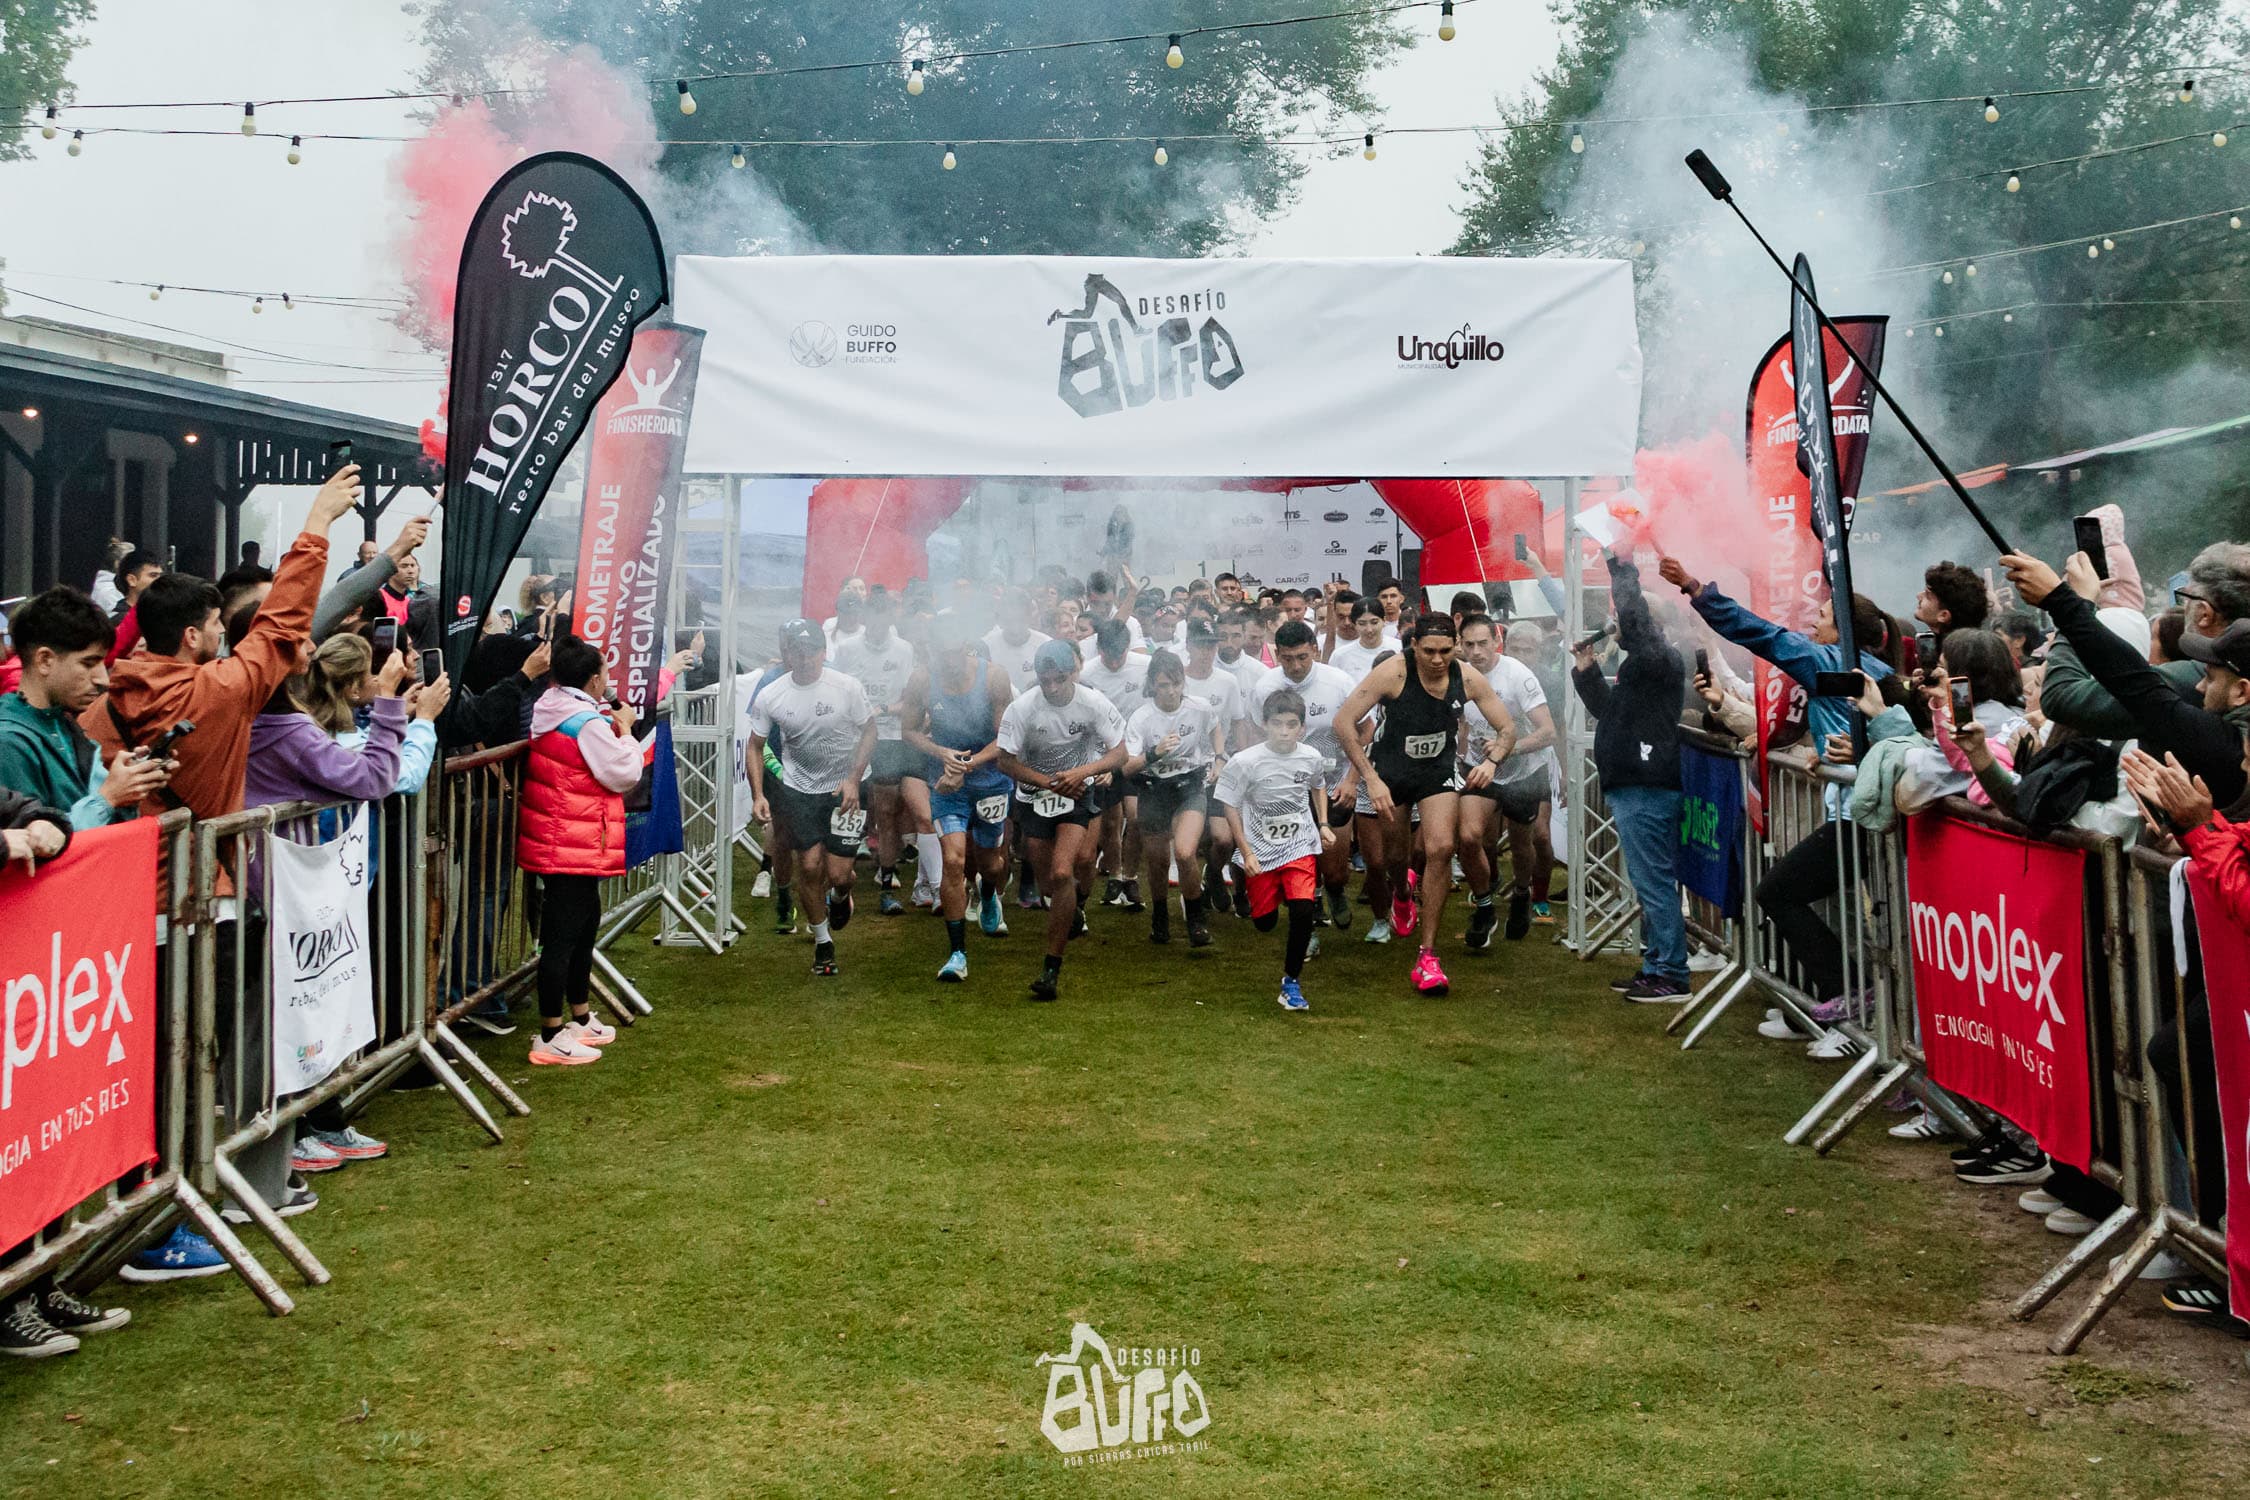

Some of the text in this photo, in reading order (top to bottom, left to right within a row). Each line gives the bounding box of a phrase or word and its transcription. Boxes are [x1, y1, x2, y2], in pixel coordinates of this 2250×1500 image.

[1139, 288, 1226, 316] DESAFÍO
[847, 324, 897, 337] GUIDO
[846, 341, 897, 353] BUFFO
[1398, 322, 1505, 370] Unquillo
[486, 348, 514, 391] 1317
[1058, 316, 1245, 419] BUFFO
[464, 286, 591, 497] HORCO
[509, 288, 640, 514] resto bar del museo
[1413, 741, 1439, 755] 197
[983, 803, 1006, 820] 227
[1041, 797, 1066, 813] 174
[837, 816, 863, 833] 252
[1911, 893, 2066, 1025] moplex
[40, 1120, 63, 1152] EN
